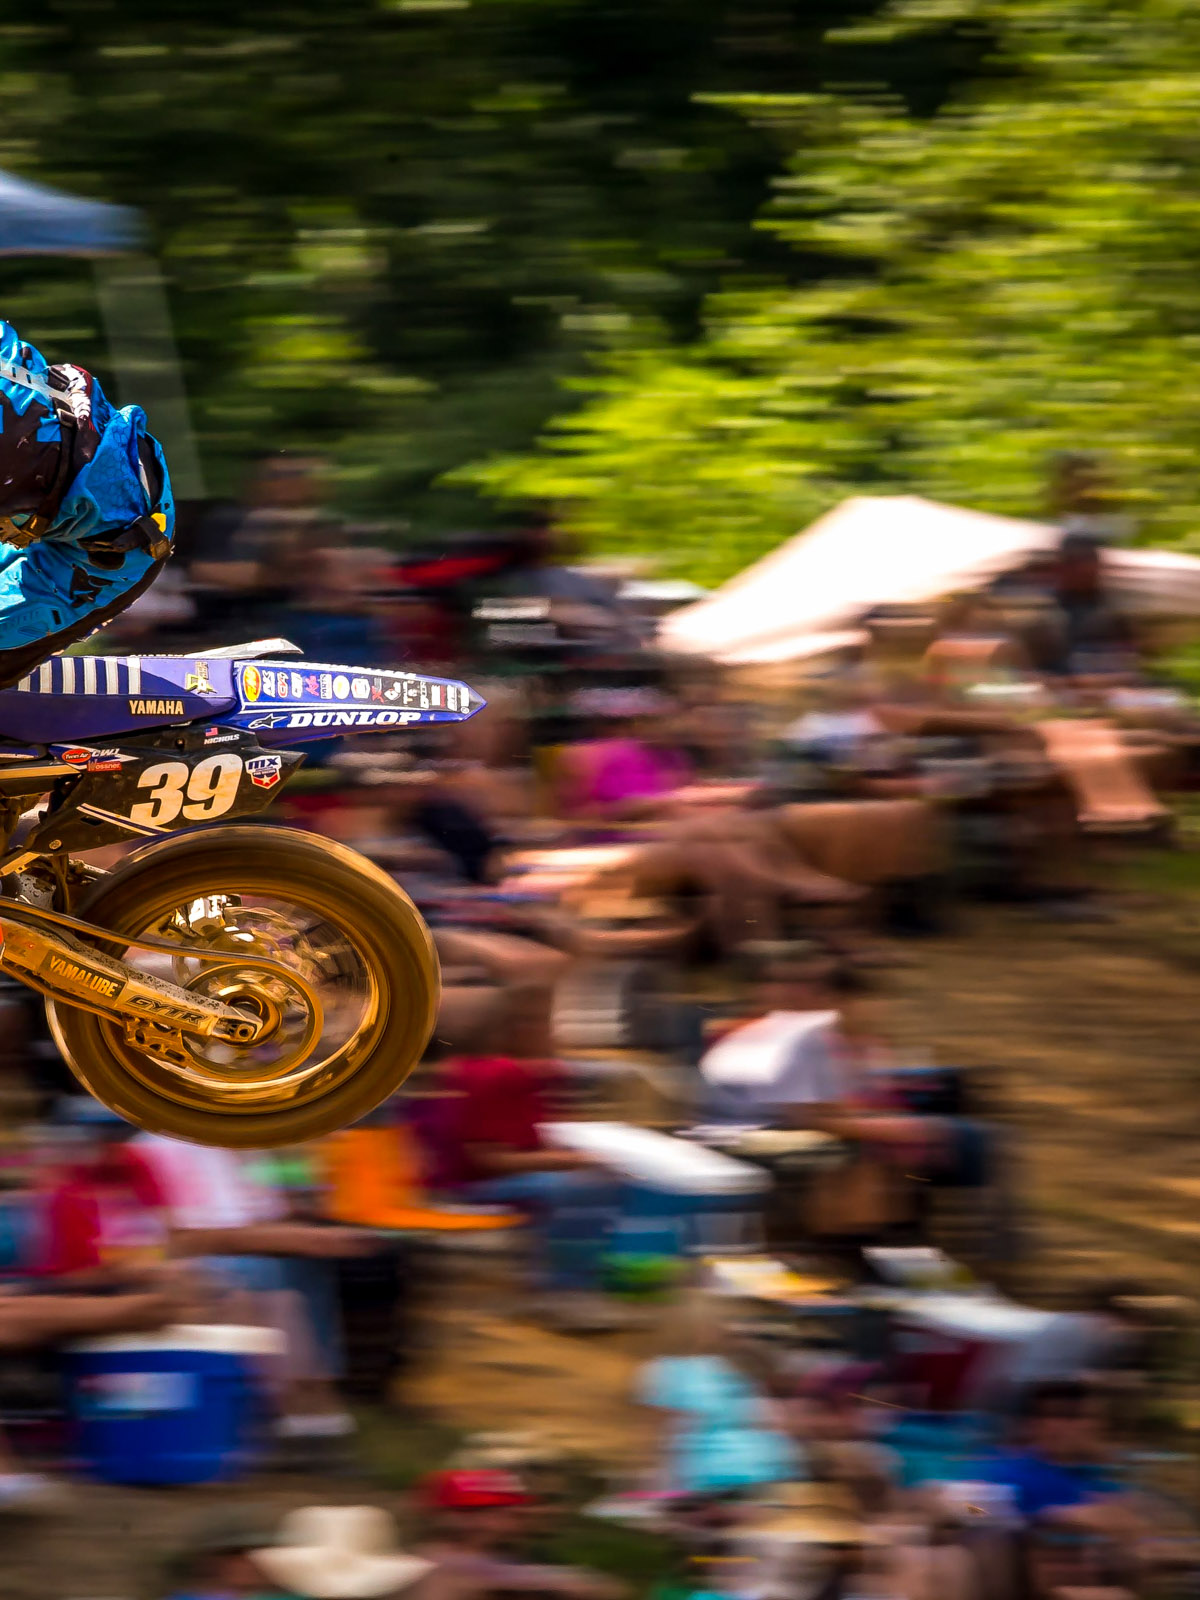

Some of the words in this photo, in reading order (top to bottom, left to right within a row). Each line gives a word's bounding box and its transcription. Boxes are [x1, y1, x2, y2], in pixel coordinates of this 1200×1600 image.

[129, 699, 184, 716] YAMAHA
[287, 711, 421, 728] DUNLOP
[203, 733, 240, 745] NICHOLS
[130, 753, 243, 826] 39
[50, 955, 119, 998] YAMALUBE
[126, 995, 206, 1024] GYTR
